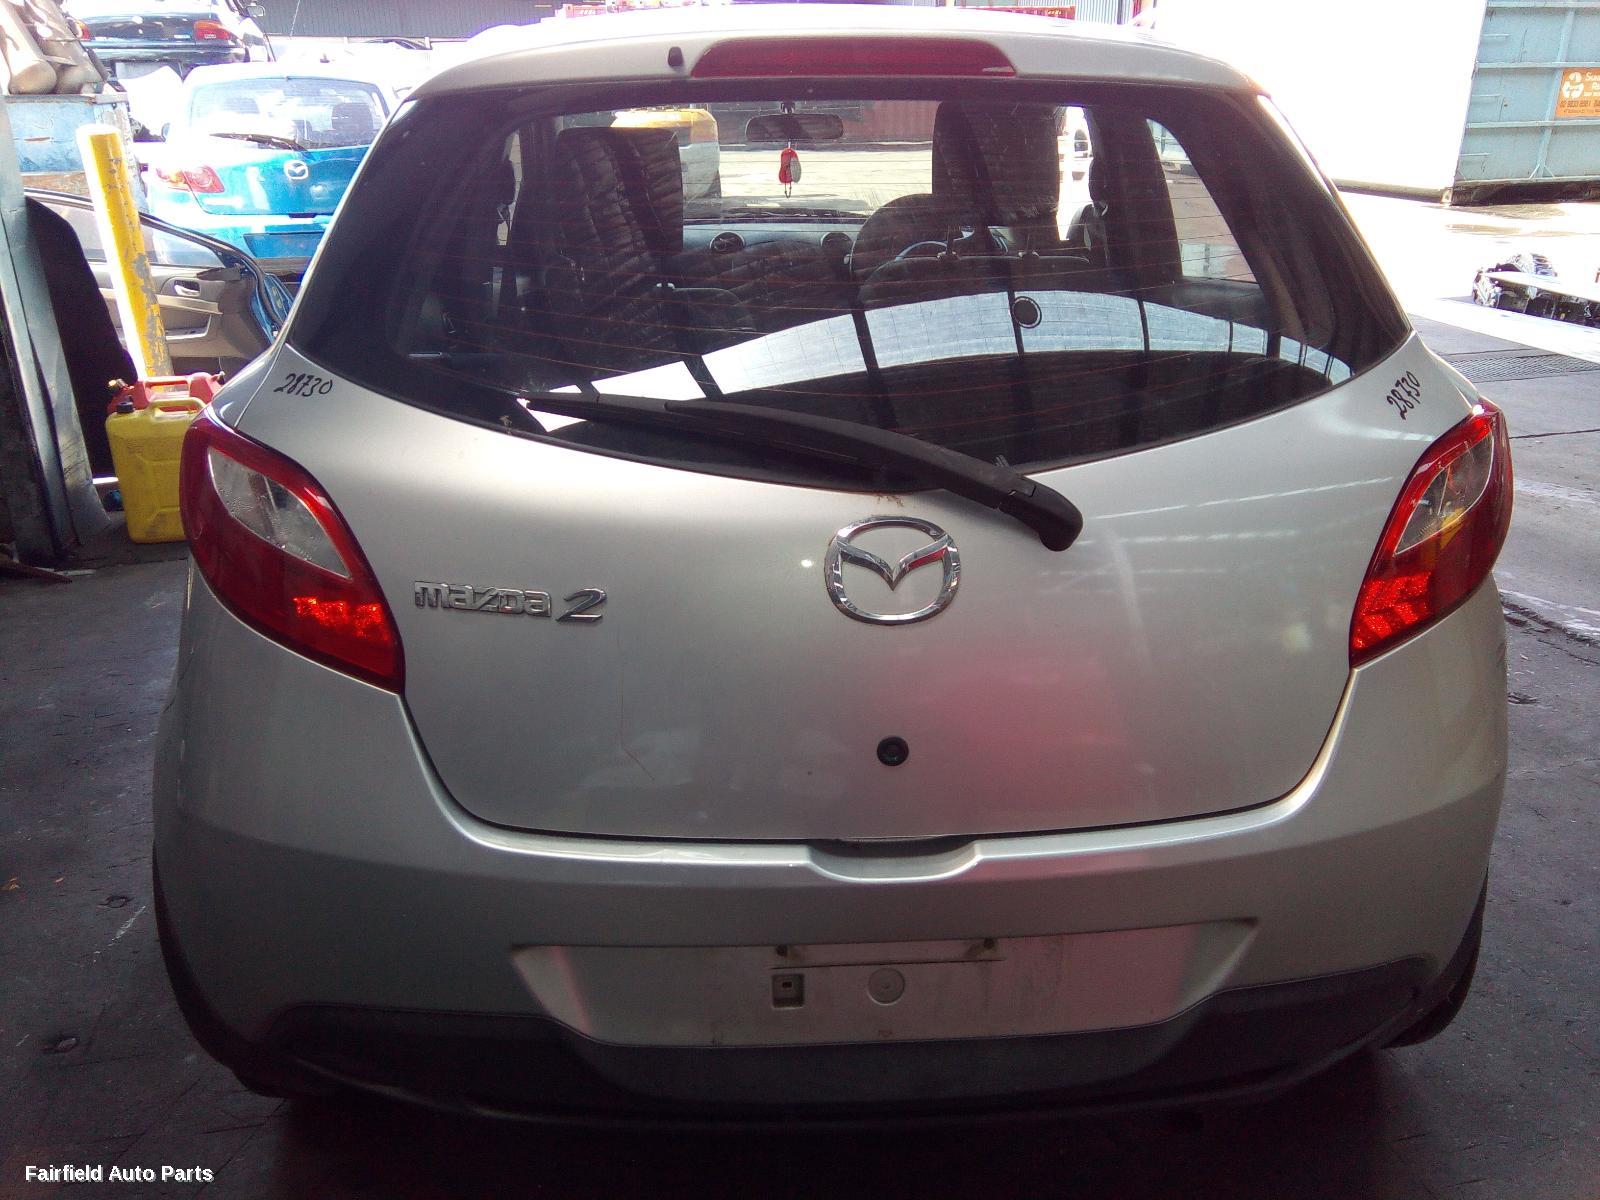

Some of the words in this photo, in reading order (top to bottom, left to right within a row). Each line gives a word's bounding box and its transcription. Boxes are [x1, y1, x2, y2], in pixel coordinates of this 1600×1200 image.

[273, 373, 333, 397] 28730
[1386, 370, 1421, 420] 28730
[555, 587, 607, 622] 2
